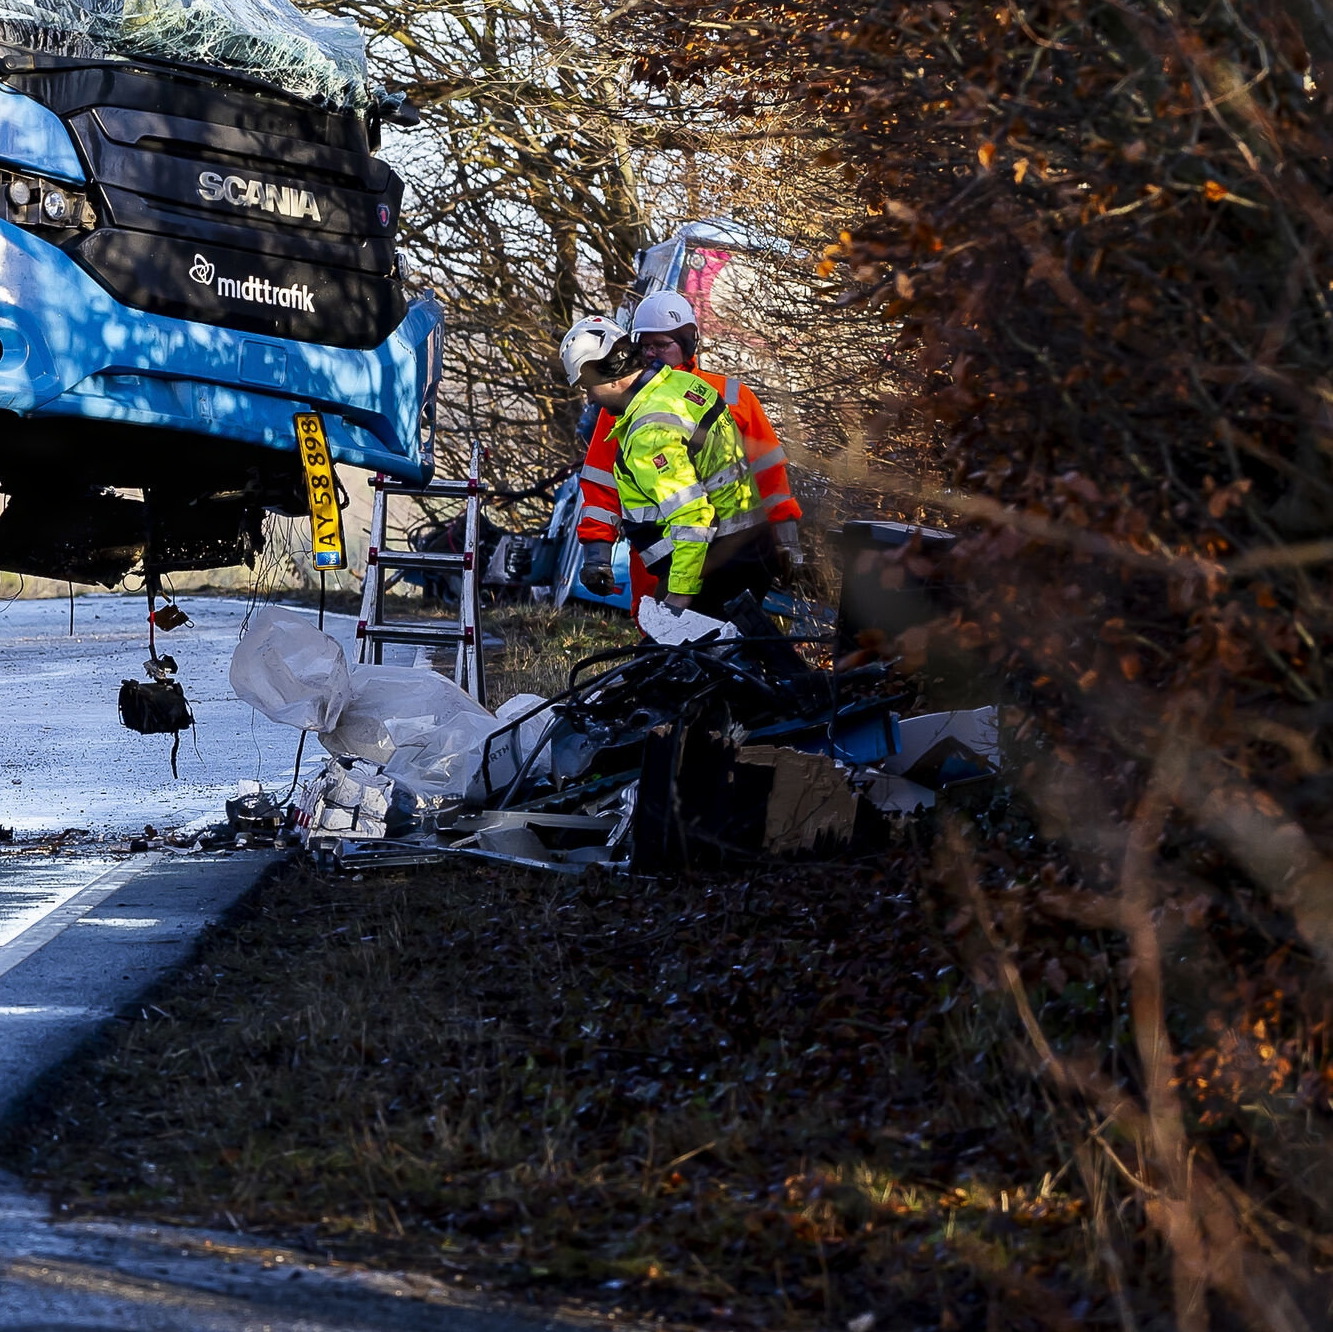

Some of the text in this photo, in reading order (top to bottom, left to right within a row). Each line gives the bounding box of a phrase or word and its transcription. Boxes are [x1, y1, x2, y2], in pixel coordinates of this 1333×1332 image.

[198, 171, 322, 222] SCANIA
[217, 275, 316, 313] midttrafik
[301, 419, 326, 466] 898
[311, 474, 332, 505] 58
[317, 514, 336, 547] AY
